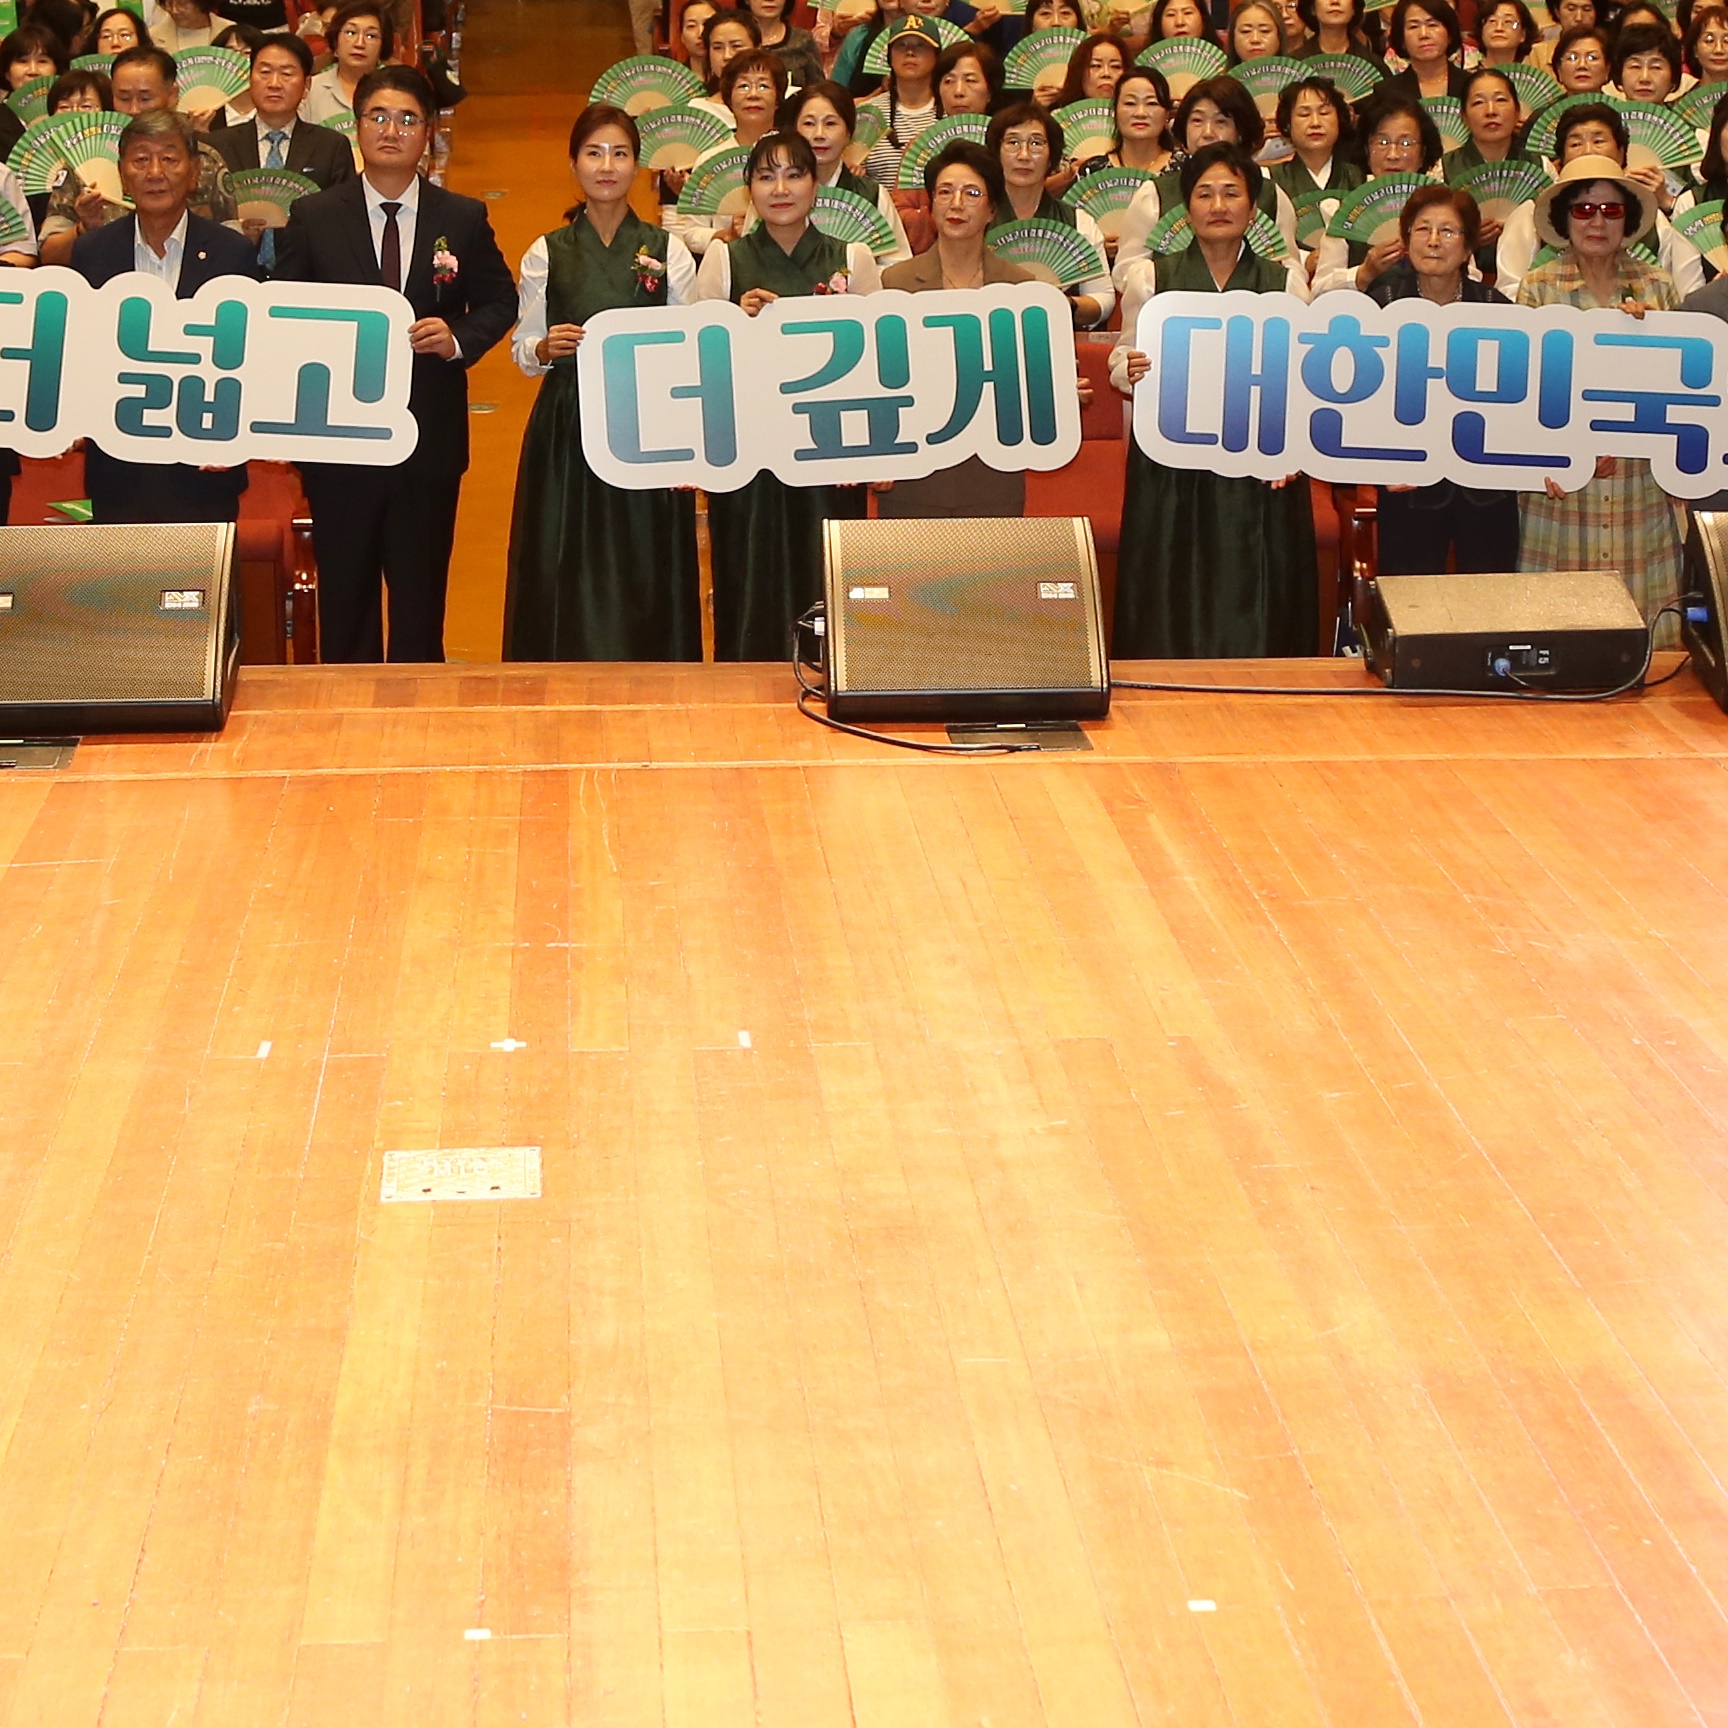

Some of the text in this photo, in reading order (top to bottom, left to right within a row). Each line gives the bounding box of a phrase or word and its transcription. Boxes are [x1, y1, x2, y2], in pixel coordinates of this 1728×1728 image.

[115, 295, 394, 442] 넓고
[601, 323, 737, 469] 더
[779, 304, 1057, 463] 깊게
